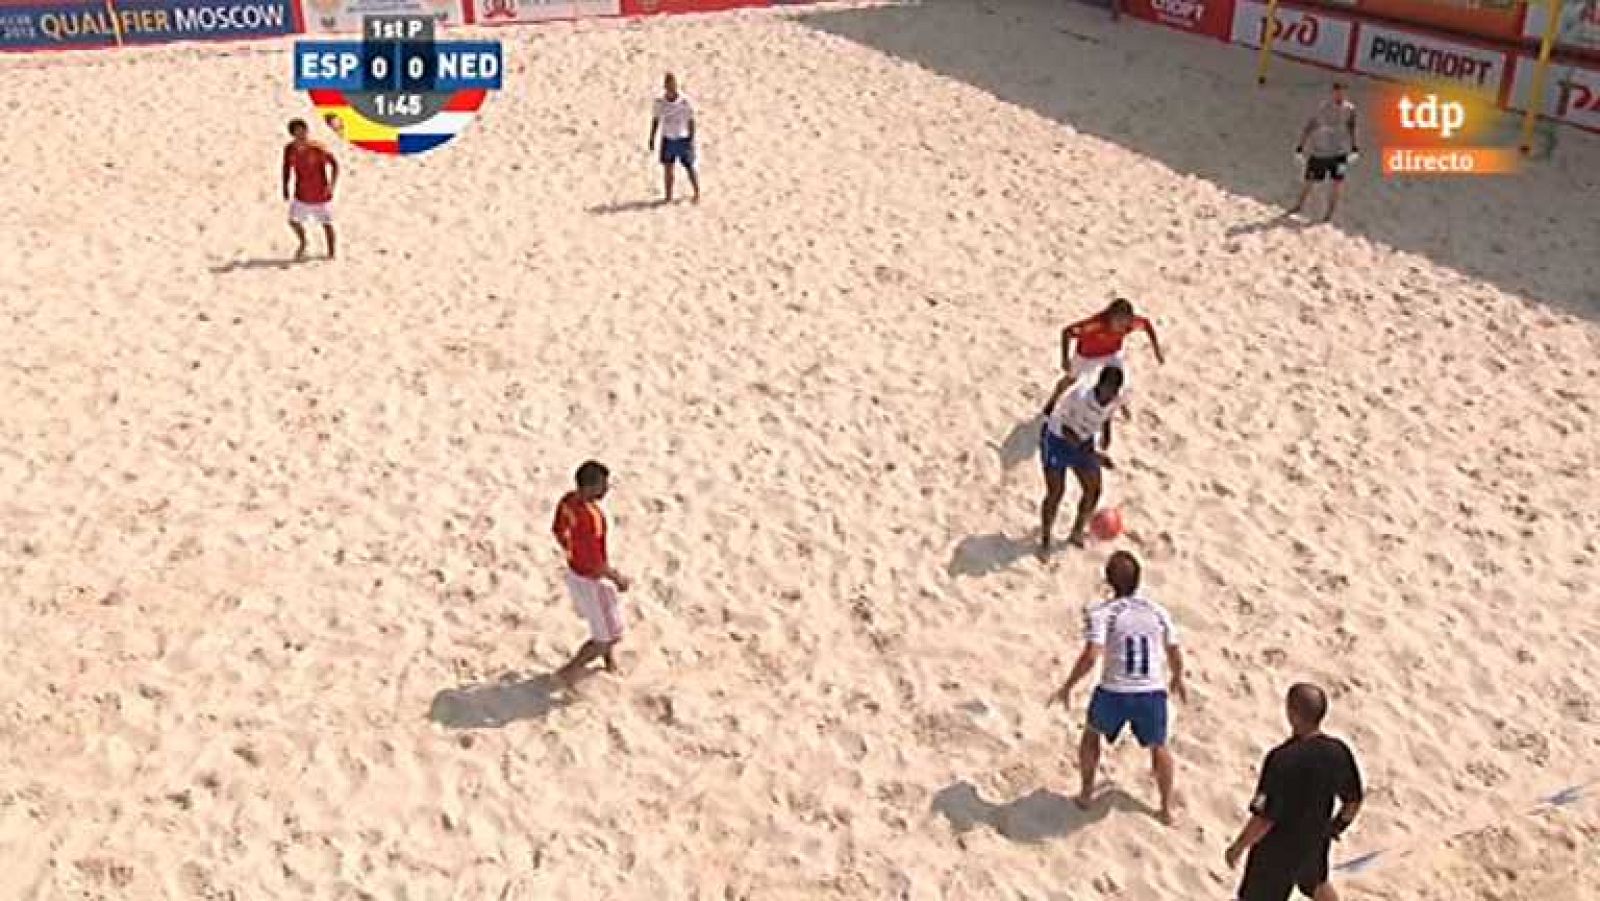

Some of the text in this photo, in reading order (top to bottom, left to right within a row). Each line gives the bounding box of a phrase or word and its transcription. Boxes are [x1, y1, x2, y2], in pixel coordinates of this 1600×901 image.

[40, 5, 284, 39] QUALFIER MOSCOW
[1125, 634, 1150, 675] 11
